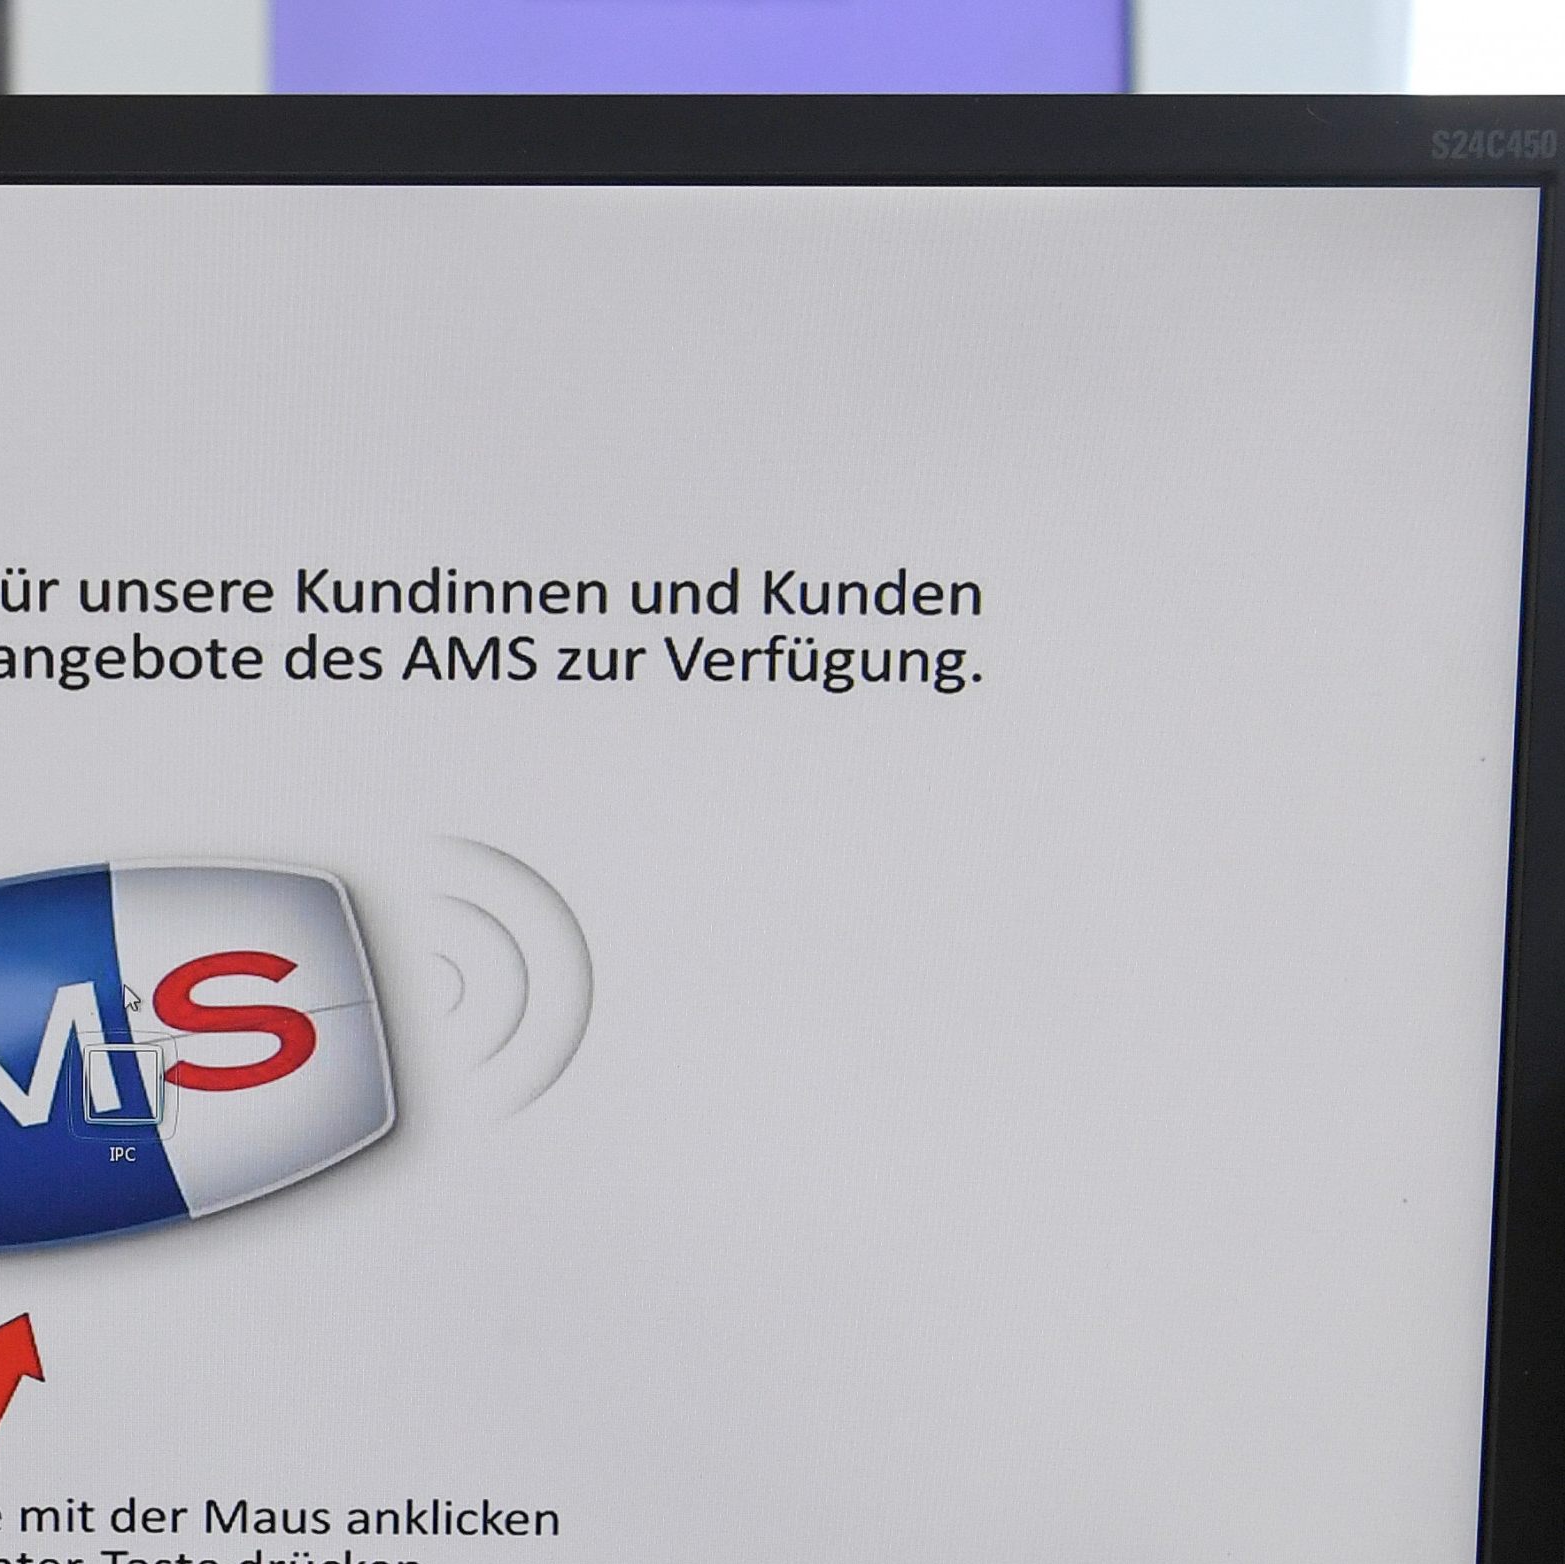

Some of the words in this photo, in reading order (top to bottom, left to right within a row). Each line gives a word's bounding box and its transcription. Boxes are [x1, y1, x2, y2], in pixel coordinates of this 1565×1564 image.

[1431, 128, 1557, 160] S24C450
[80, 579, 274, 613] unsere
[298, 566, 607, 614] Kundinnen
[632, 567, 738, 615] und
[764, 568, 981, 615] Kunden
[285, 633, 382, 680] des
[402, 636, 537, 681] AMS
[557, 648, 646, 681] zur
[664, 635, 982, 694] Verfügung.
[110, 1147, 136, 1162] IPC
[21, 1498, 95, 1532] mit
[111, 1497, 188, 1533] der
[206, 1500, 330, 1534] Maus
[347, 1499, 558, 1535] anklicken
